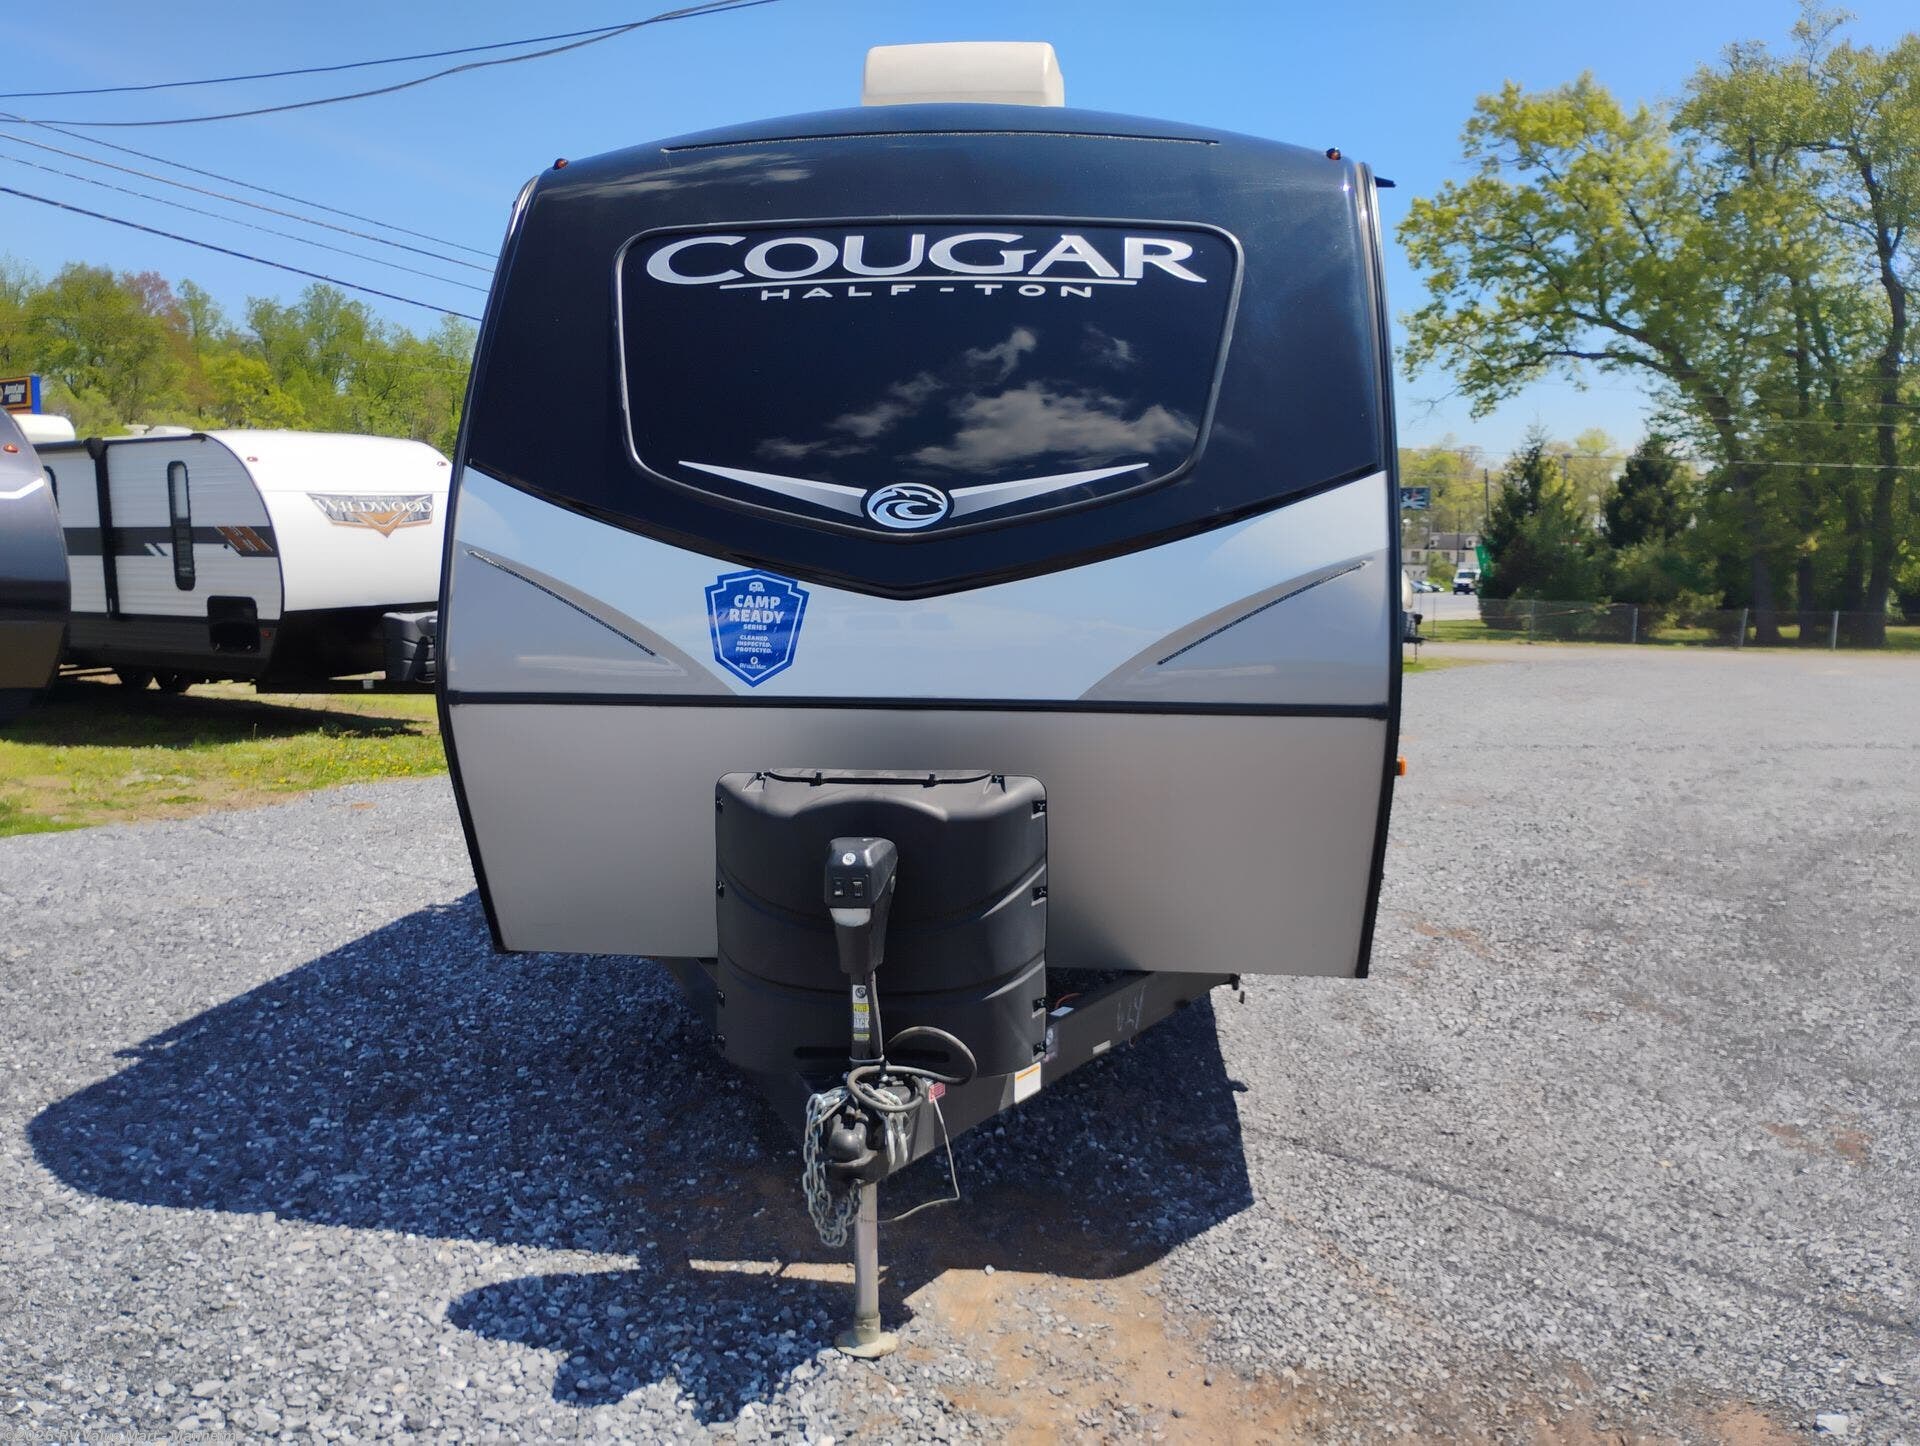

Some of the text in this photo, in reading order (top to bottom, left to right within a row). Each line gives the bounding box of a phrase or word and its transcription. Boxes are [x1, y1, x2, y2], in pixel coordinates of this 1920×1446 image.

[646, 232, 1207, 285] COUGAR
[311, 496, 432, 513] WILDWOOD
[734, 594, 781, 609] CAMP
[729, 608, 785, 624] READY
[743, 623, 767, 631] SERIES
